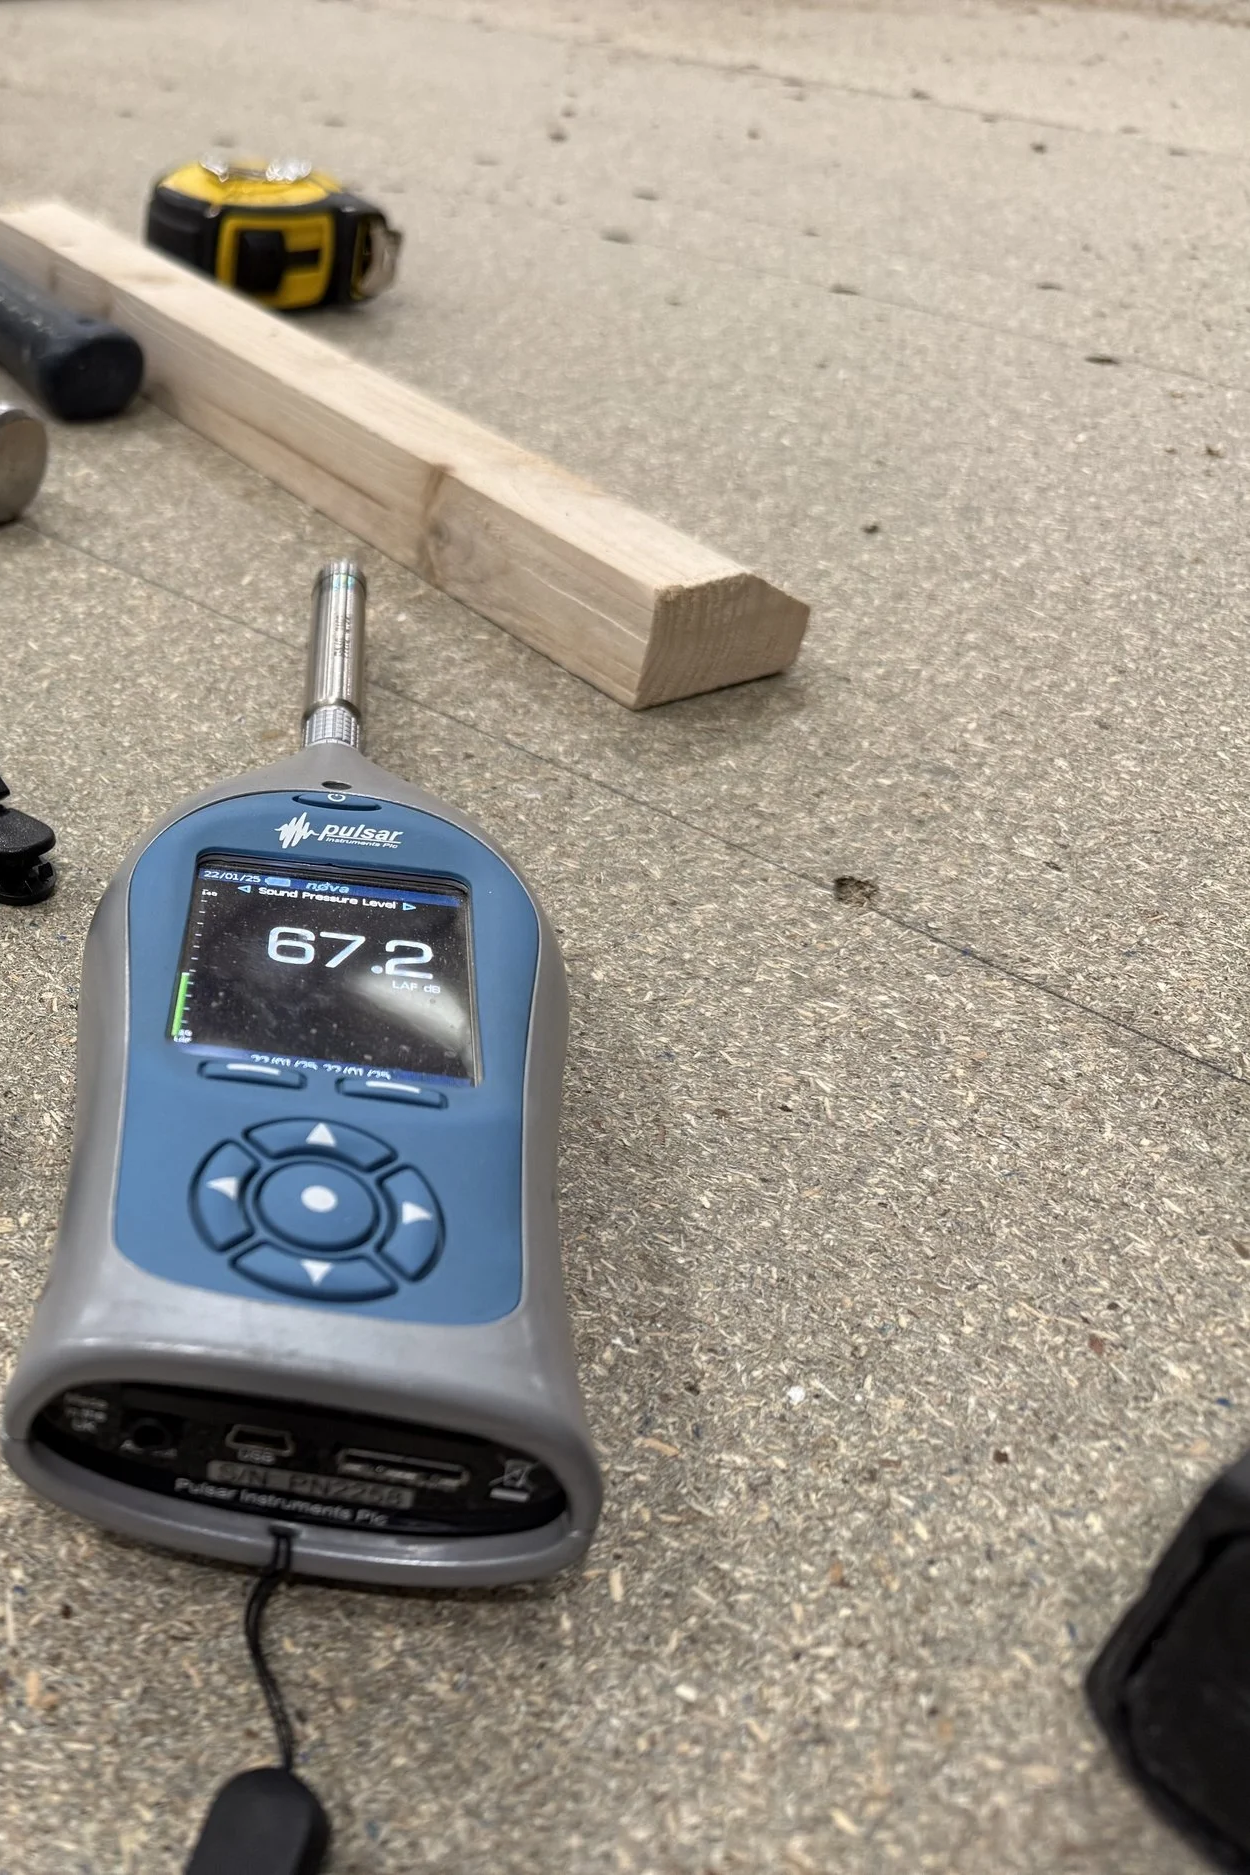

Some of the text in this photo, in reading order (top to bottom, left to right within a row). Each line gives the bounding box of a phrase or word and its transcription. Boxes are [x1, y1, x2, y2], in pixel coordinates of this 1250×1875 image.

[317, 823, 404, 843] pulsar
[203, 869, 261, 884] 22/01/25
[258, 886, 397, 910] Sound Pressure Level
[267, 926, 434, 980] 67.2
[423, 984, 441, 995] dB
[174, 1477, 239, 1500] Pulsar
[239, 1488, 354, 1520] Instruments
